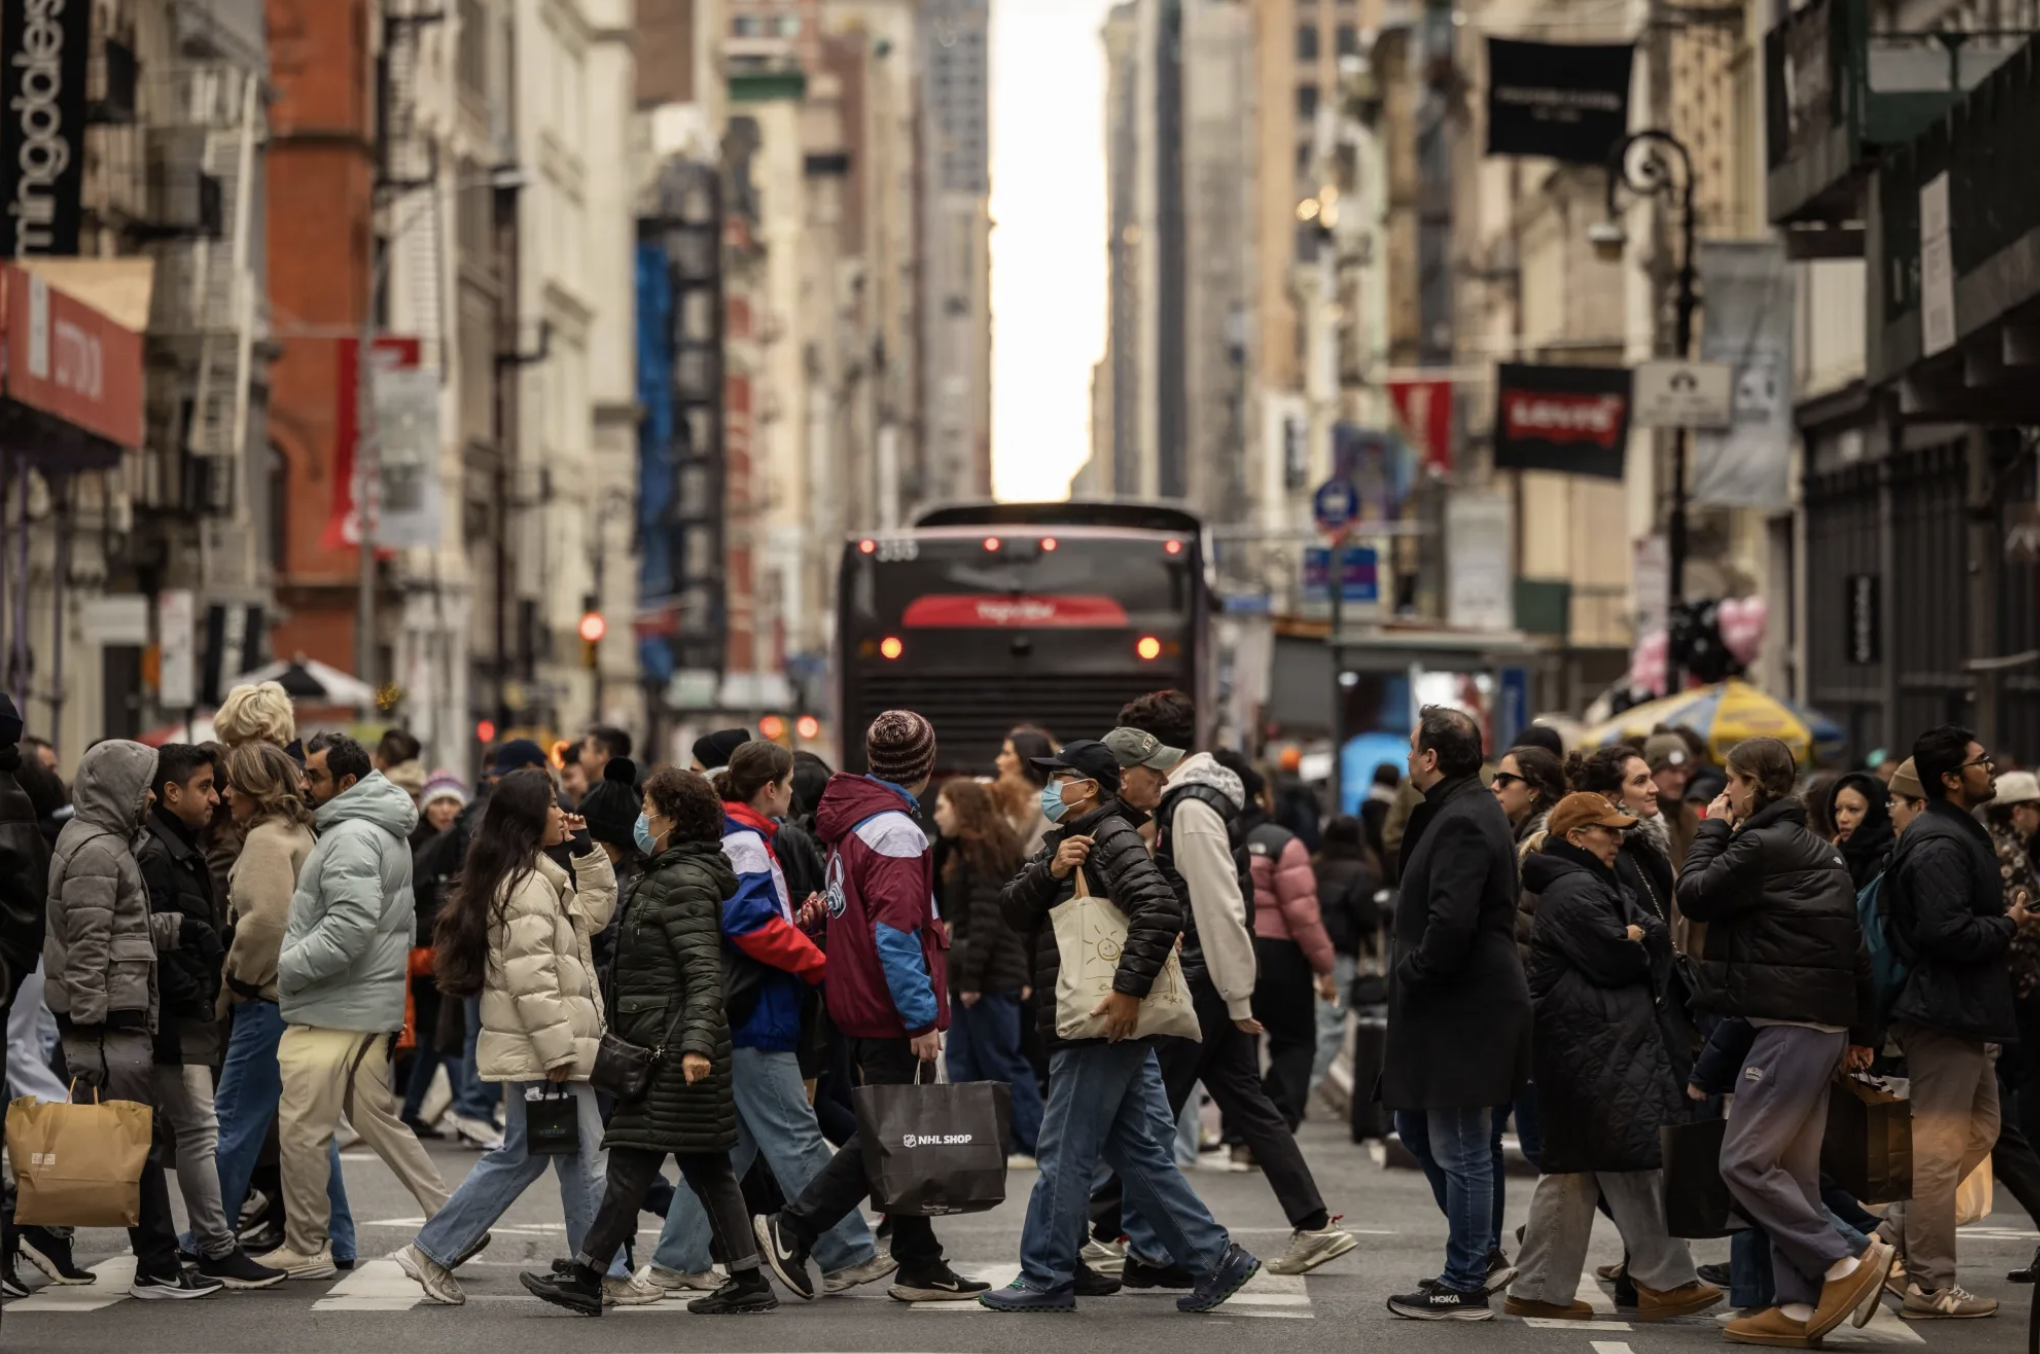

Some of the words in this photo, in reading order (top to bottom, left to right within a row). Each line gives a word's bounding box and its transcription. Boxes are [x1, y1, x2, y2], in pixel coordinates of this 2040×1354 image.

[918, 1135, 942, 1145] NHL
[943, 1134, 973, 1144] SHOP
[1429, 1294, 1461, 1304] HOKA
